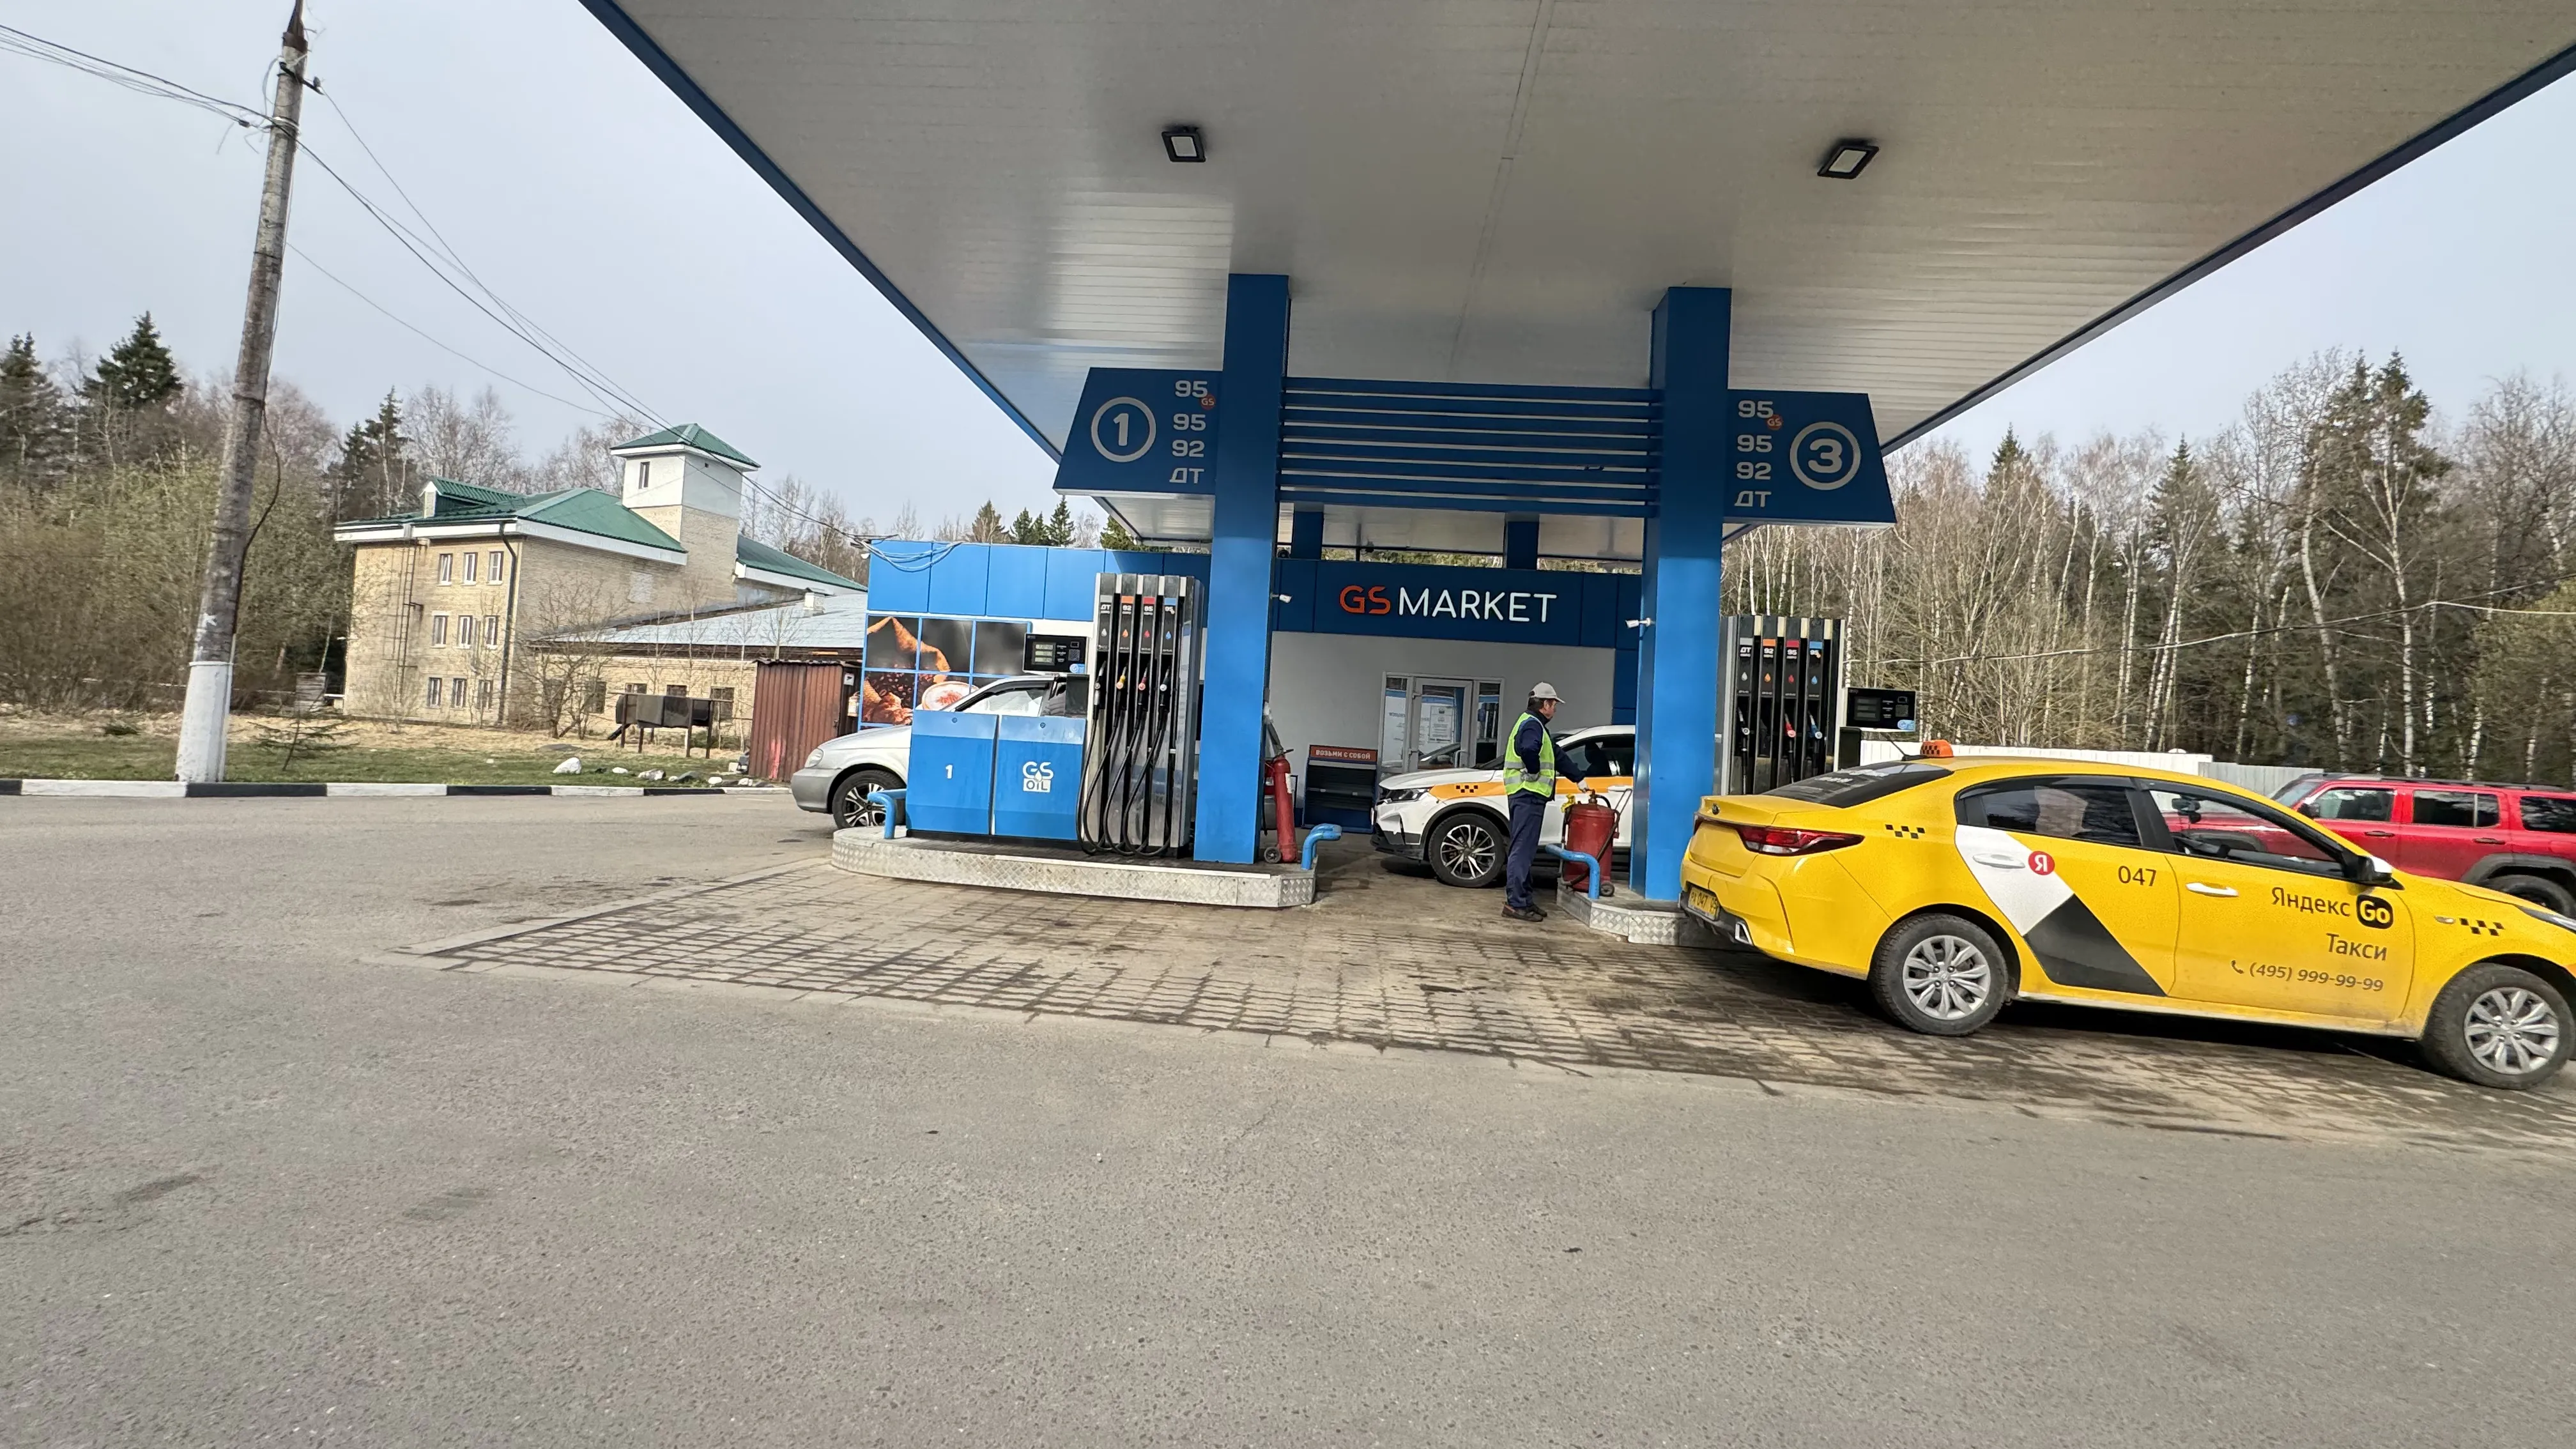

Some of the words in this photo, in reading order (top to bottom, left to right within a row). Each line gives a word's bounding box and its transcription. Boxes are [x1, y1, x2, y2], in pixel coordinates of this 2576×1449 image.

[1175, 380, 1208, 398] 95
[1200, 397, 1215, 406] GS
[1738, 400, 1774, 418] 95
[1113, 413, 1129, 447] 1
[1173, 413, 1206, 431] 95
[1767, 418, 1782, 427] GS
[1172, 440, 1205, 458] 92
[1737, 434, 1773, 453] 95
[1807, 438, 1843, 473] 3
[1169, 467, 1205, 484] ДТ
[1736, 461, 1772, 480] 92
[1734, 490, 1772, 508] ДТ
[1339, 585, 1391, 615] GS
[1399, 586, 1558, 623] MARKET
[1315, 749, 1342, 758] ВОЗЬМИ
[945, 764, 953, 779] 1
[1022, 761, 1054, 780] GS
[1026, 780, 1048, 791] OIL
[2034, 854, 2048, 873] Я
[2118, 865, 2157, 887] 047
[2271, 887, 2351, 917] Яндекс
[2359, 900, 2391, 924] Go
[2326, 933, 2388, 961] Такси
[2250, 962, 2293, 982] (495)
[2297, 969, 2384, 992] 999-99-99
